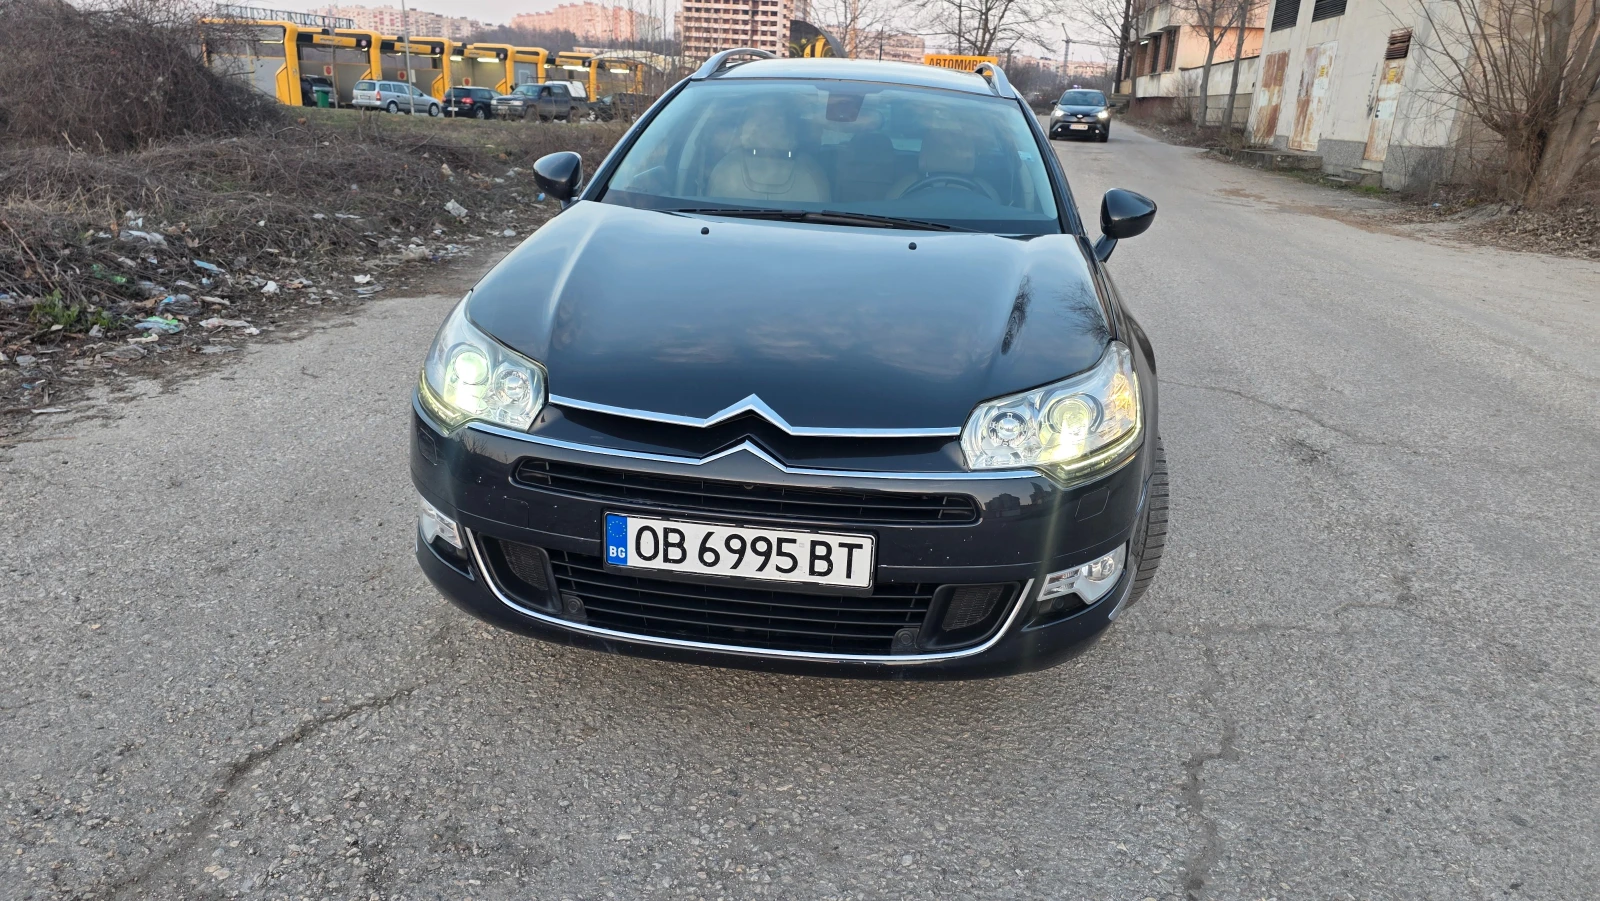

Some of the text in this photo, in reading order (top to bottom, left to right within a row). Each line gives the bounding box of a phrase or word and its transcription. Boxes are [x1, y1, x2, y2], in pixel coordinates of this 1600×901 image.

[929, 58, 992, 71] АВТОМИВ
[609, 545, 626, 559] BG
[635, 525, 864, 580] OB 6995 BT
